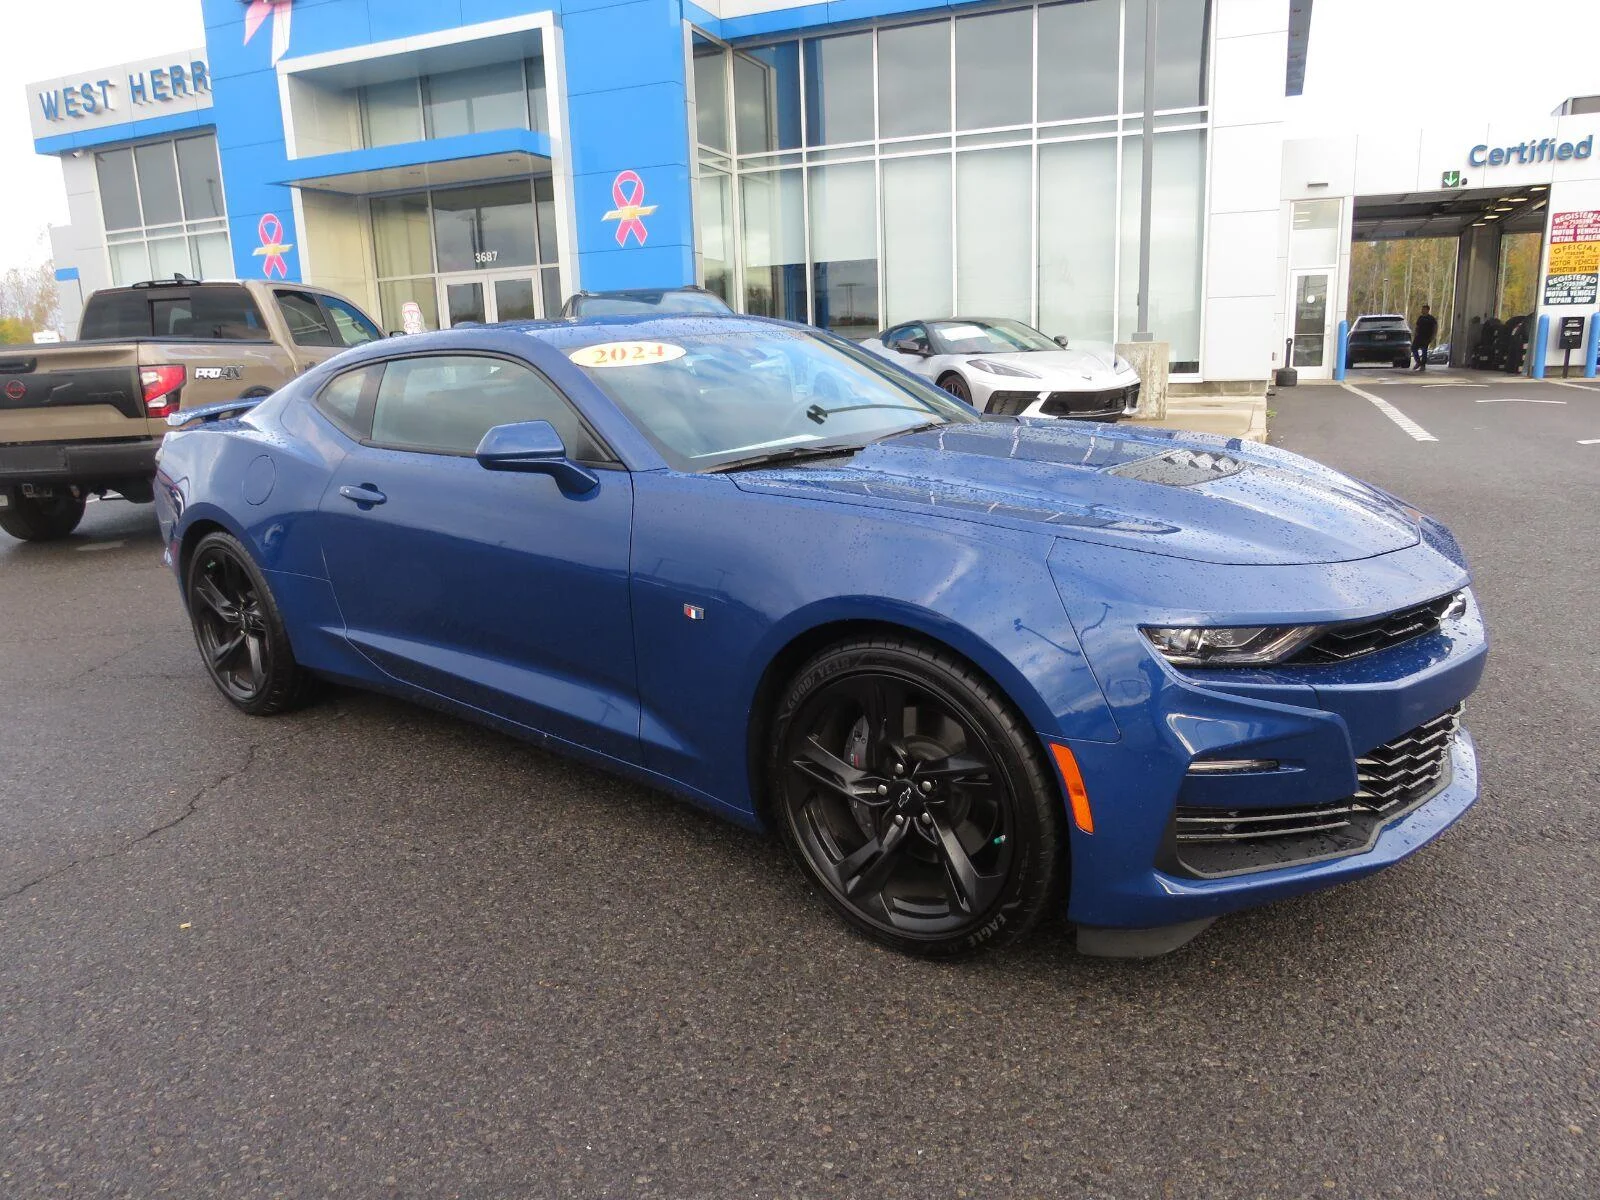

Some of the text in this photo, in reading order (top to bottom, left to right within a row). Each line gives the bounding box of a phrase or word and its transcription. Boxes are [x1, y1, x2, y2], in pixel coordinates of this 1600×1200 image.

[39, 60, 212, 121] WEST HERR
[1469, 134, 1593, 167] Certified
[1577, 227, 1600, 235] VEHICL
[1553, 243, 1598, 254] OFFICIAL
[475, 251, 497, 263] 3687
[1549, 259, 1571, 267] MOTOR
[1547, 274, 1597, 286] REGISTERED
[1570, 289, 1596, 297] VEHICLE
[1548, 296, 1592, 304] REPAIR SHOP
[593, 344, 664, 364] 2024
